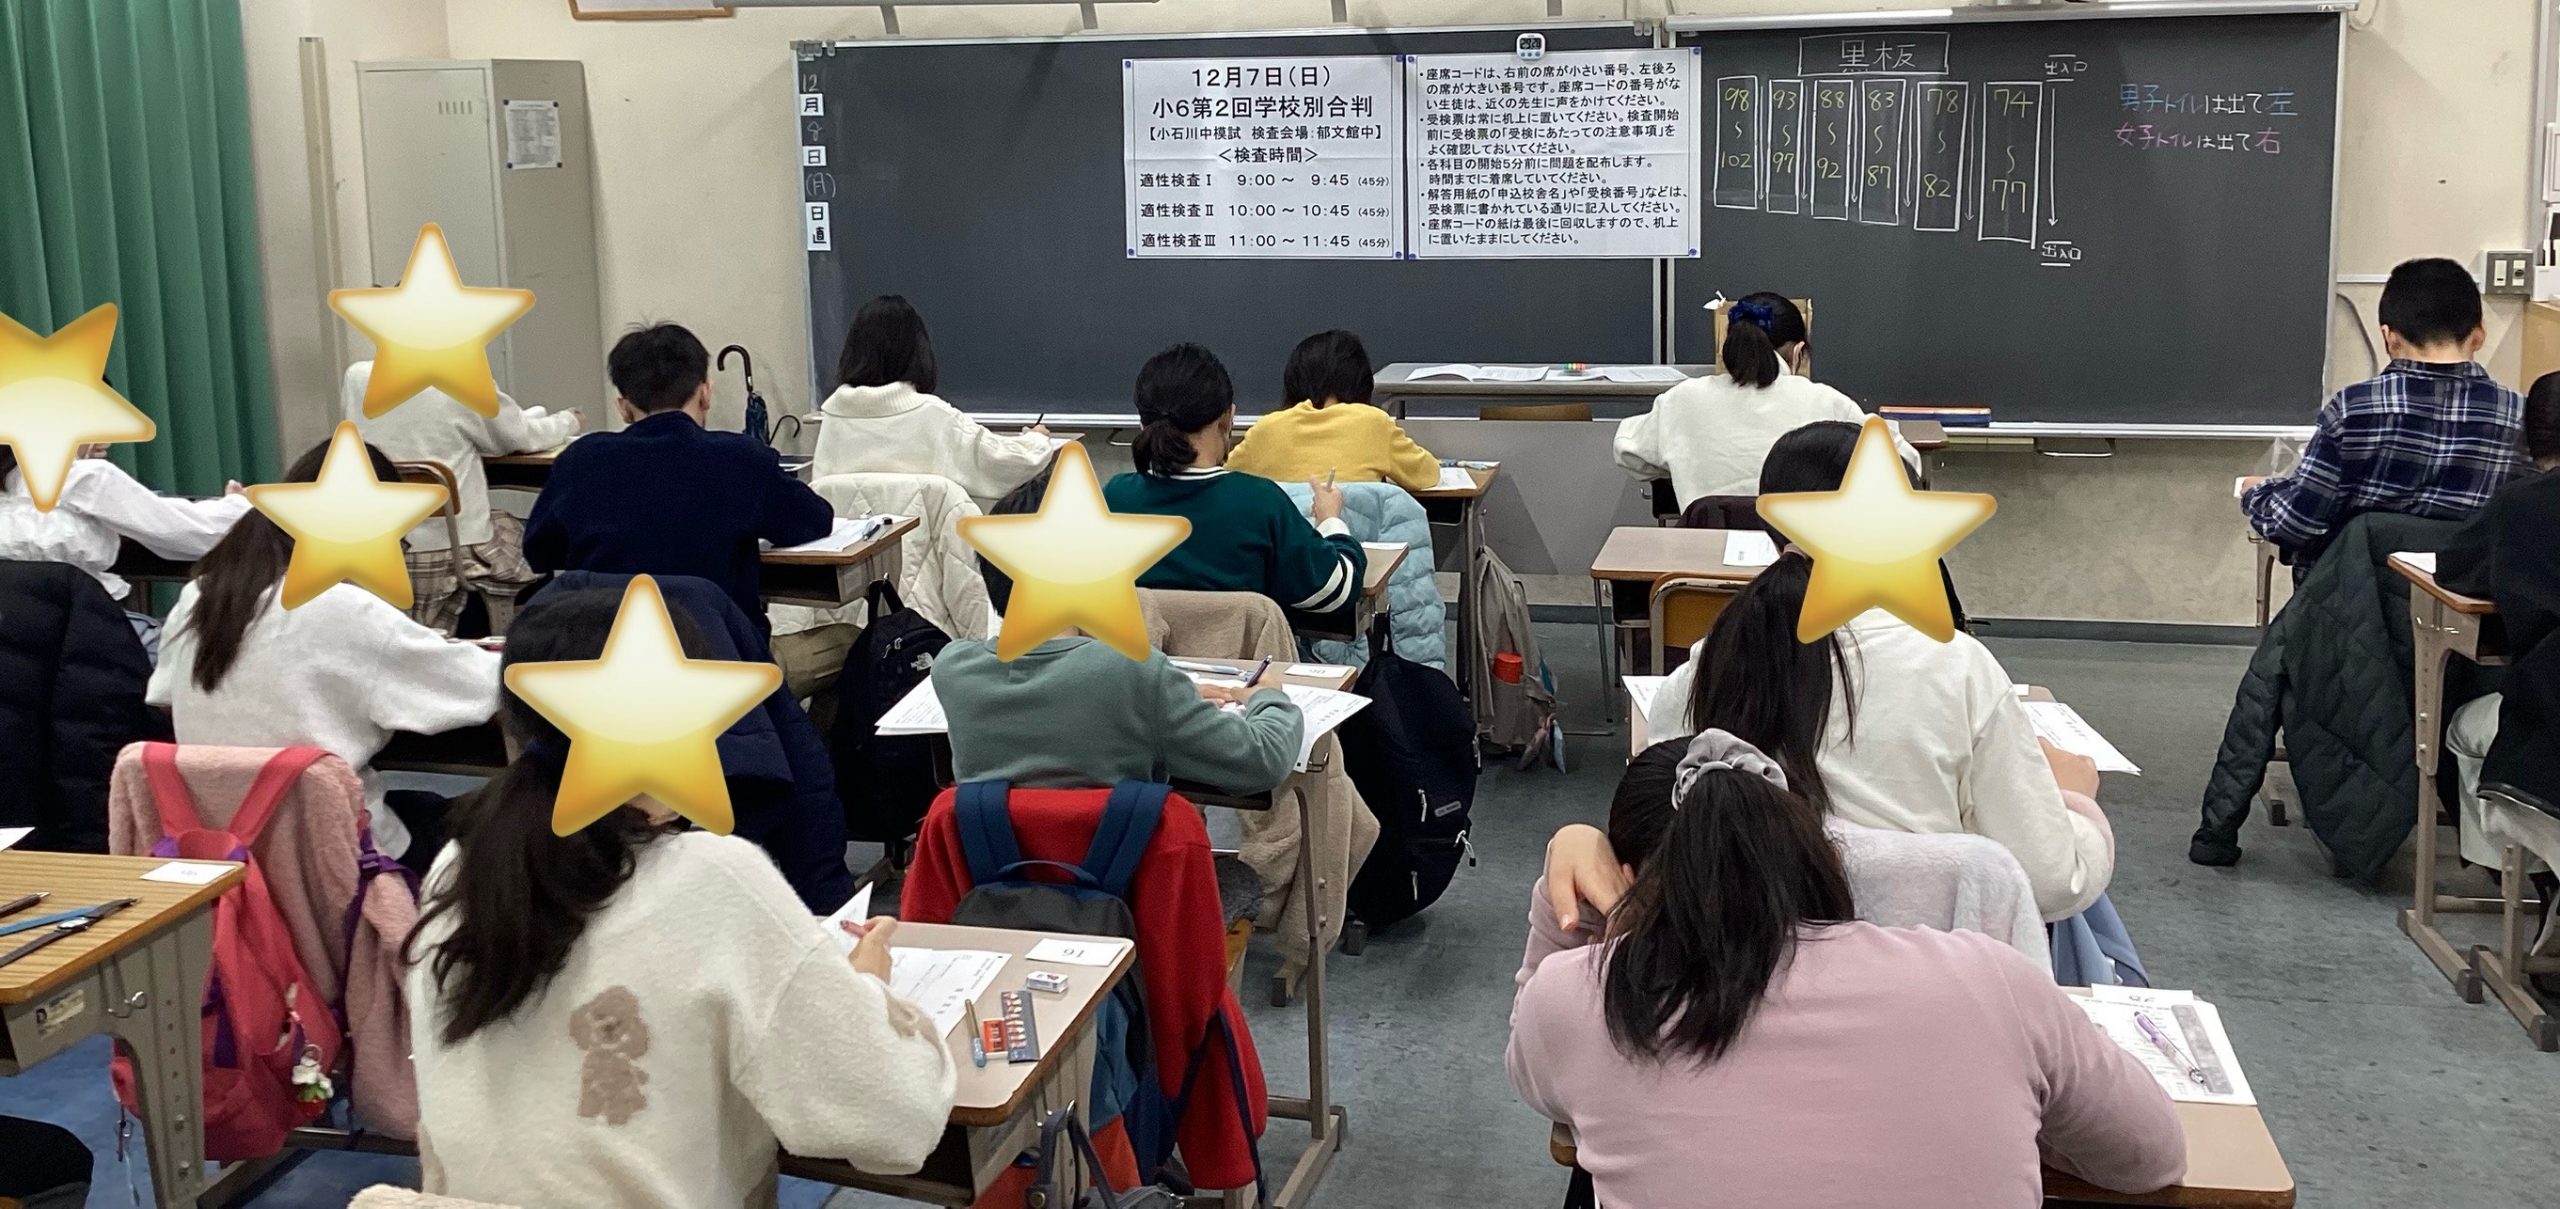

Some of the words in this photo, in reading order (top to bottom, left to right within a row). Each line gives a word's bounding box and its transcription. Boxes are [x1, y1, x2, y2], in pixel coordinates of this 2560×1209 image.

[1838, 39, 1917, 72] 黒板
[1192, 65, 1332, 88] 12月7日（日）
[2044, 61, 2087, 75] 出入口
[1426, 78, 1681, 95] の席が大きい番号です。座席コードの番号がな
[1152, 95, 1373, 119] 小6第2回学校別合判
[1426, 95, 1667, 111] い生徒は、近くの先生に声をかけてください。
[1724, 88, 1750, 111] 98
[1772, 90, 1796, 110] 93
[1820, 90, 1845, 109] 88
[1868, 91, 1895, 111] 83
[1926, 89, 1958, 114] 78
[1993, 89, 2033, 119] 74
[2120, 83, 2298, 116] 男子トイレは出て左
[1149, 126, 1241, 141] 【小石川中模試
[1427, 124, 1676, 141] 前に受検票の「受検にあたっての注意事項」を
[2114, 122, 2280, 154] 女子トイレは出て右
[1219, 147, 1318, 163] ＜検査時間＞
[1427, 142, 1576, 156] よく確認しておいてください。
[1720, 150, 1753, 169] 102
[1772, 151, 1795, 173] 97
[1816, 156, 1842, 179] 92
[1237, 174, 1276, 187] 9:00
[1311, 174, 1350, 187] 9:45
[1358, 176, 1390, 187] (45分)
[1429, 172, 1607, 186] 時間までに着席していてください。
[1867, 165, 1891, 189] 87
[1923, 175, 1951, 198] 82
[1991, 179, 2027, 213] 77
[1229, 204, 1276, 217] 10:00
[1302, 204, 1350, 217] 10:45
[1358, 207, 1390, 218] (45分)
[1428, 200, 1681, 216] 受検票に書かれている通りに記入してください。
[1229, 235, 1276, 247] 11:00
[1302, 234, 1350, 247] 11:45
[1358, 237, 1390, 248] (45分)
[1428, 231, 1580, 246] に置いたままにしてください。
